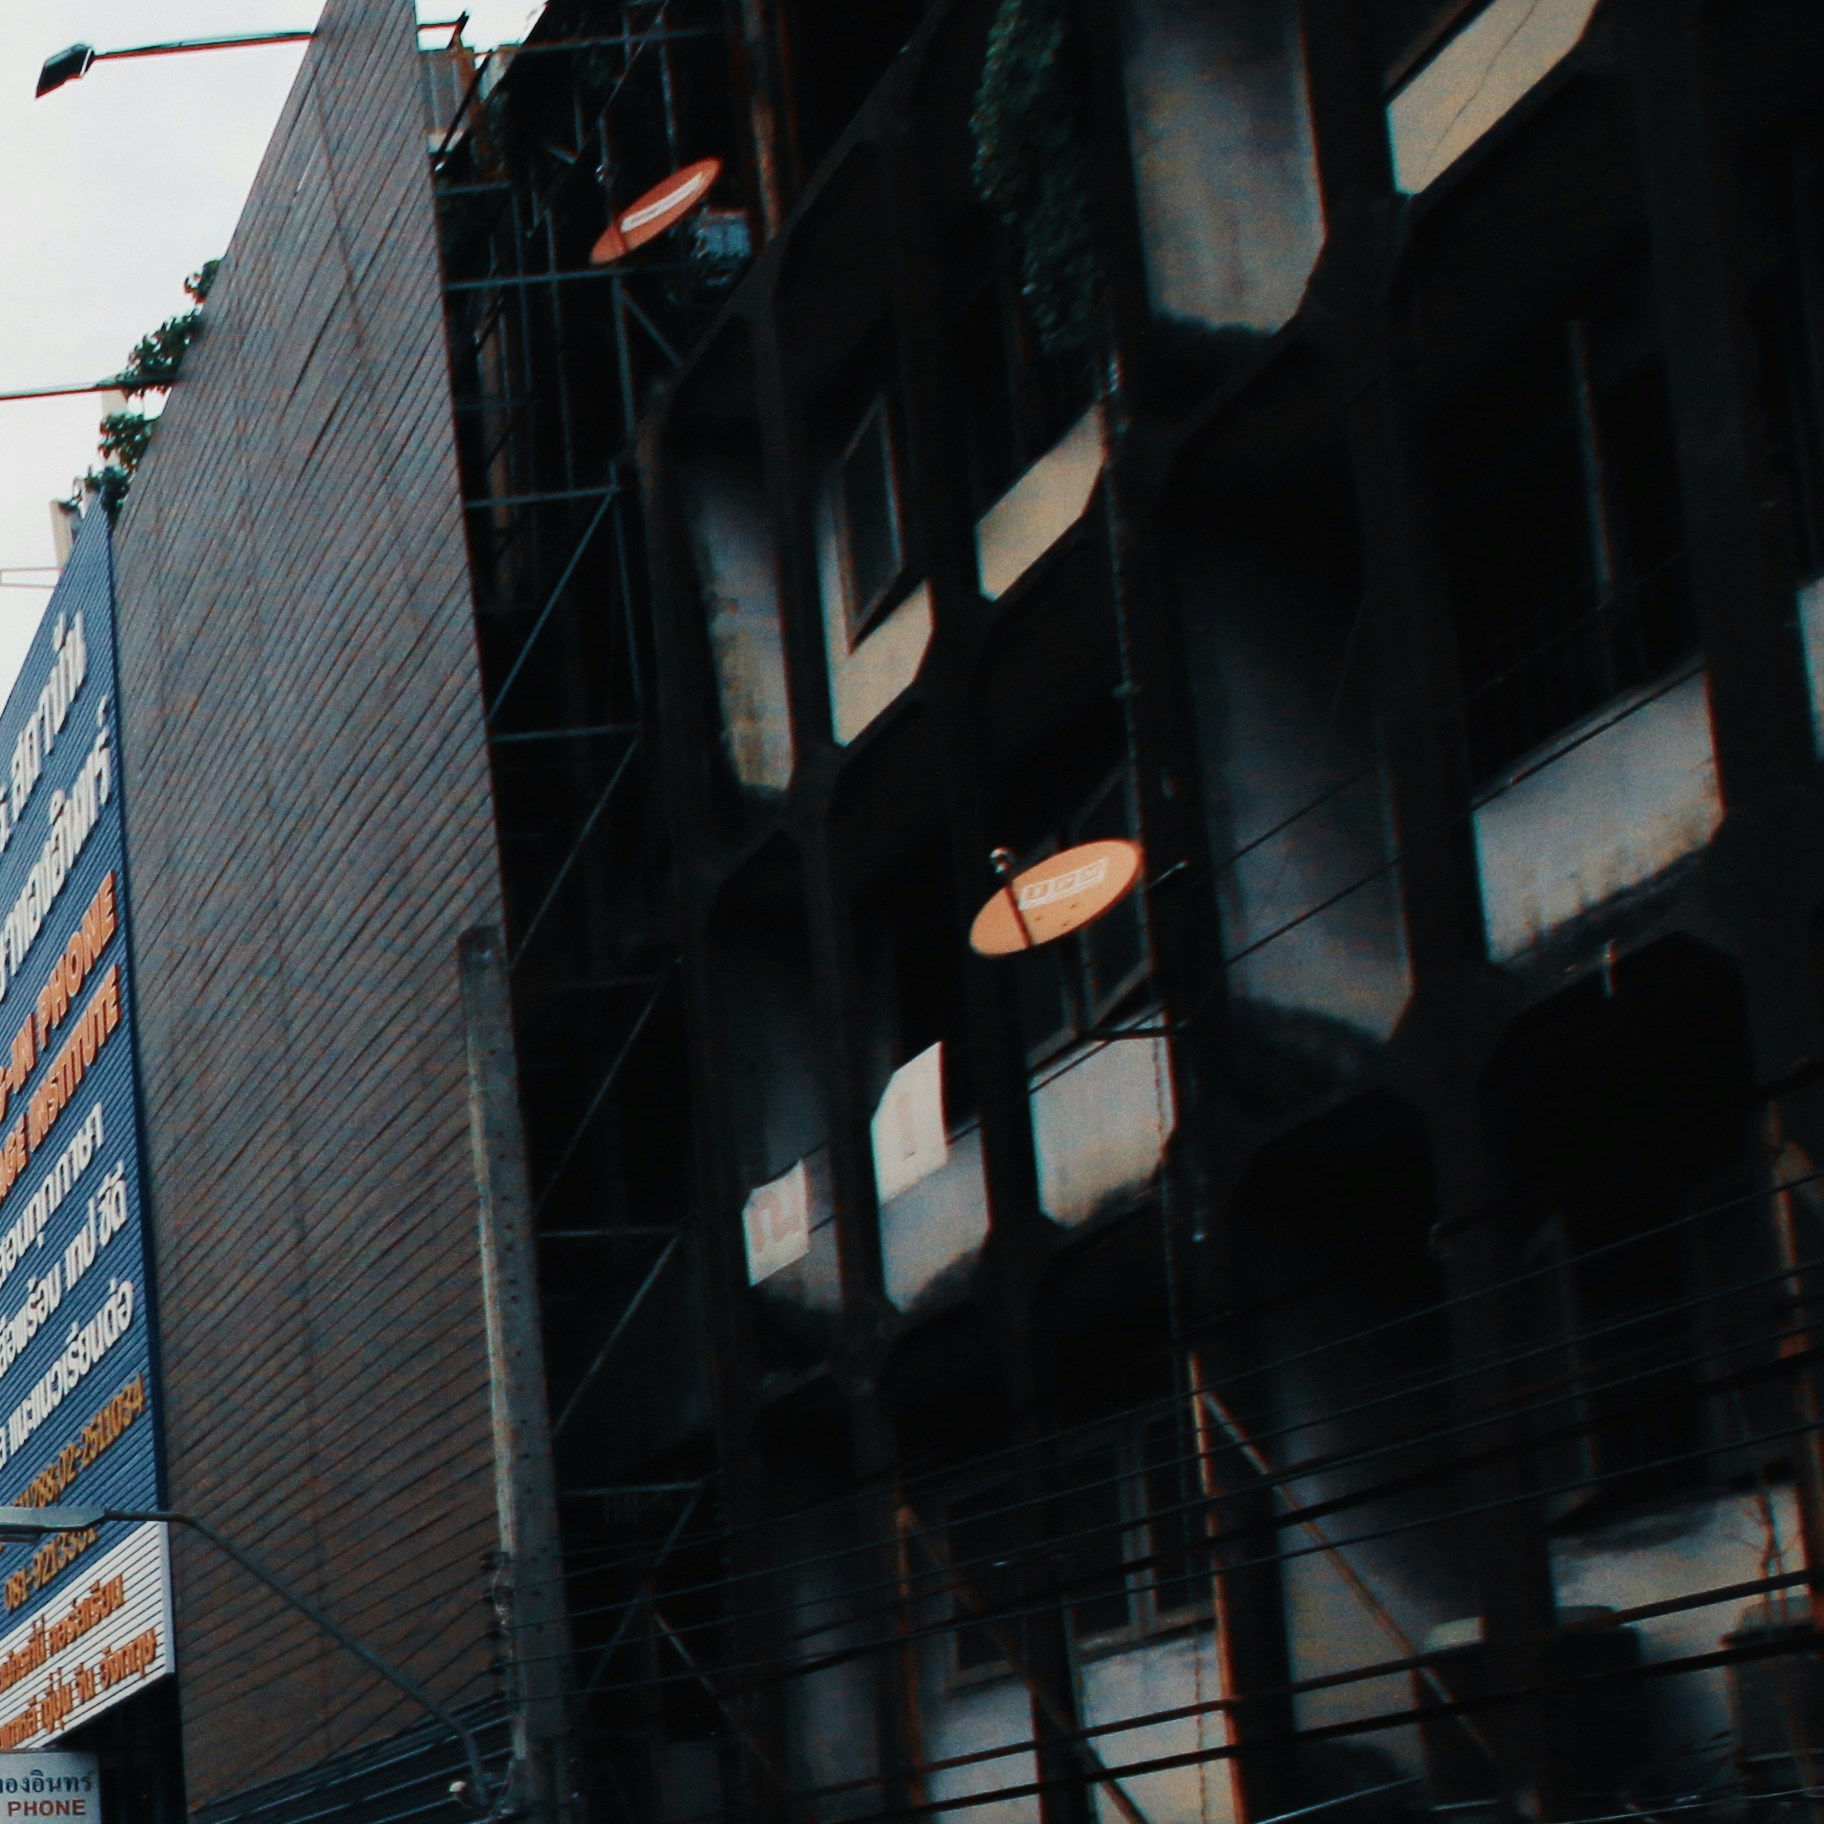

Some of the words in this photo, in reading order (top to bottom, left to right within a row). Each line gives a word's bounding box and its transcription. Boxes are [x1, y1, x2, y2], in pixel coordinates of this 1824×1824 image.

[37, 870, 118, 1051] PHONE
[29, 964, 121, 1152] INSTITUTE
[8, 1799, 87, 1817] PHONE
